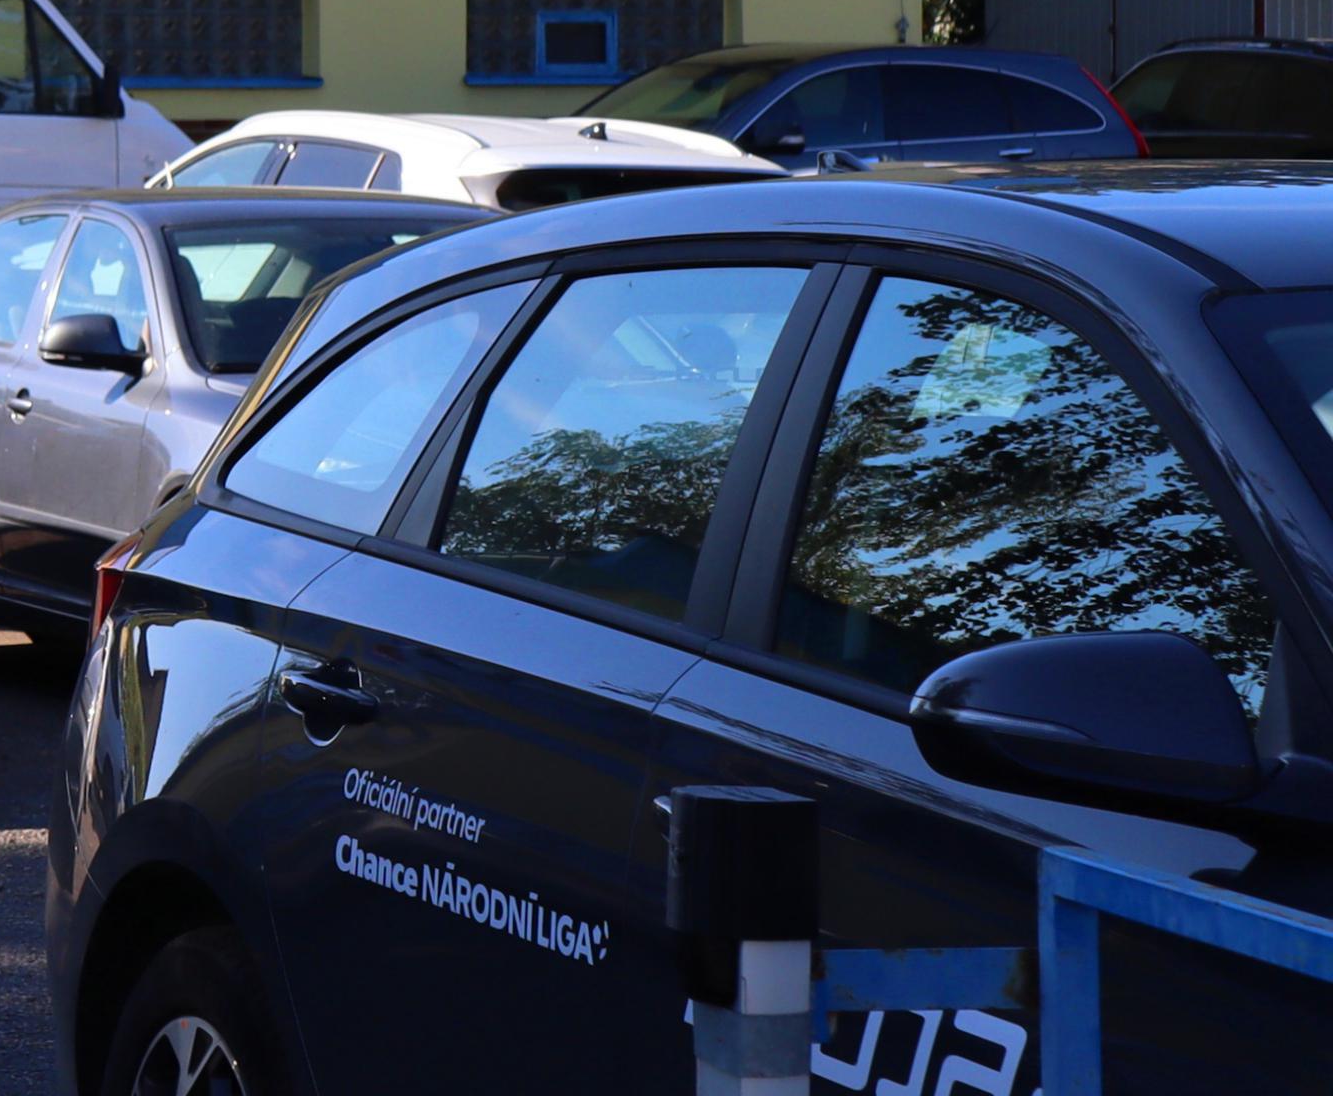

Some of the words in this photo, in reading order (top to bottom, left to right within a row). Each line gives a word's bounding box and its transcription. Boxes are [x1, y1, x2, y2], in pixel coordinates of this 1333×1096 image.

[343, 767, 418, 820] Oficiální
[413, 795, 486, 844] partner
[335, 834, 419, 897] Chance
[536, 905, 595, 966] LIGA
